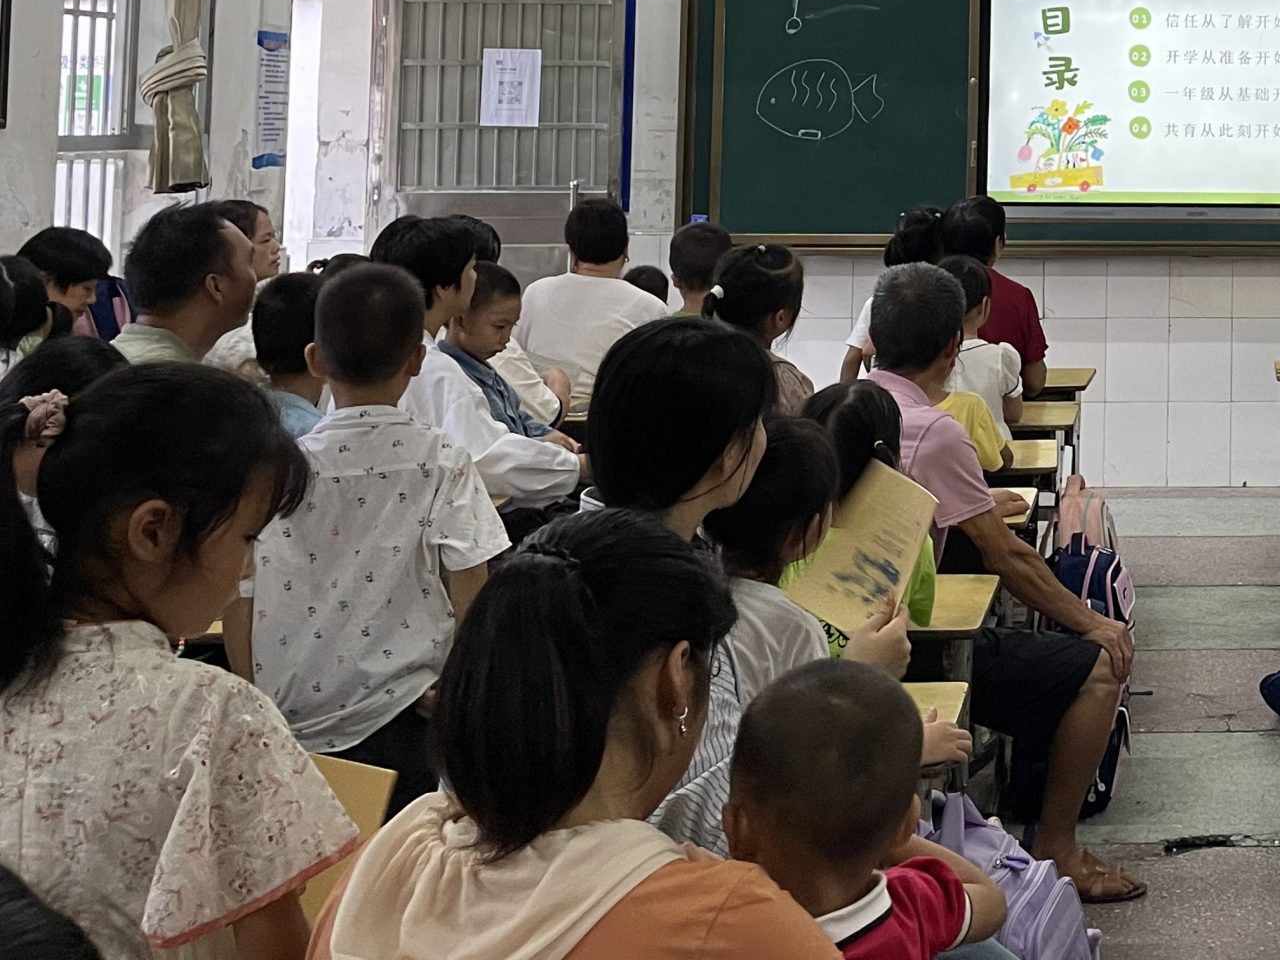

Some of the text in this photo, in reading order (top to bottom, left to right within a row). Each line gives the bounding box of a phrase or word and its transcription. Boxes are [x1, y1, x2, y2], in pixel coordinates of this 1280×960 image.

[1132, 14, 1148, 24] 01
[1041, 6, 1080, 90] 目录
[1131, 52, 1148, 61] 02
[1130, 87, 1147, 97] 03
[1130, 123, 1148, 134] 04
